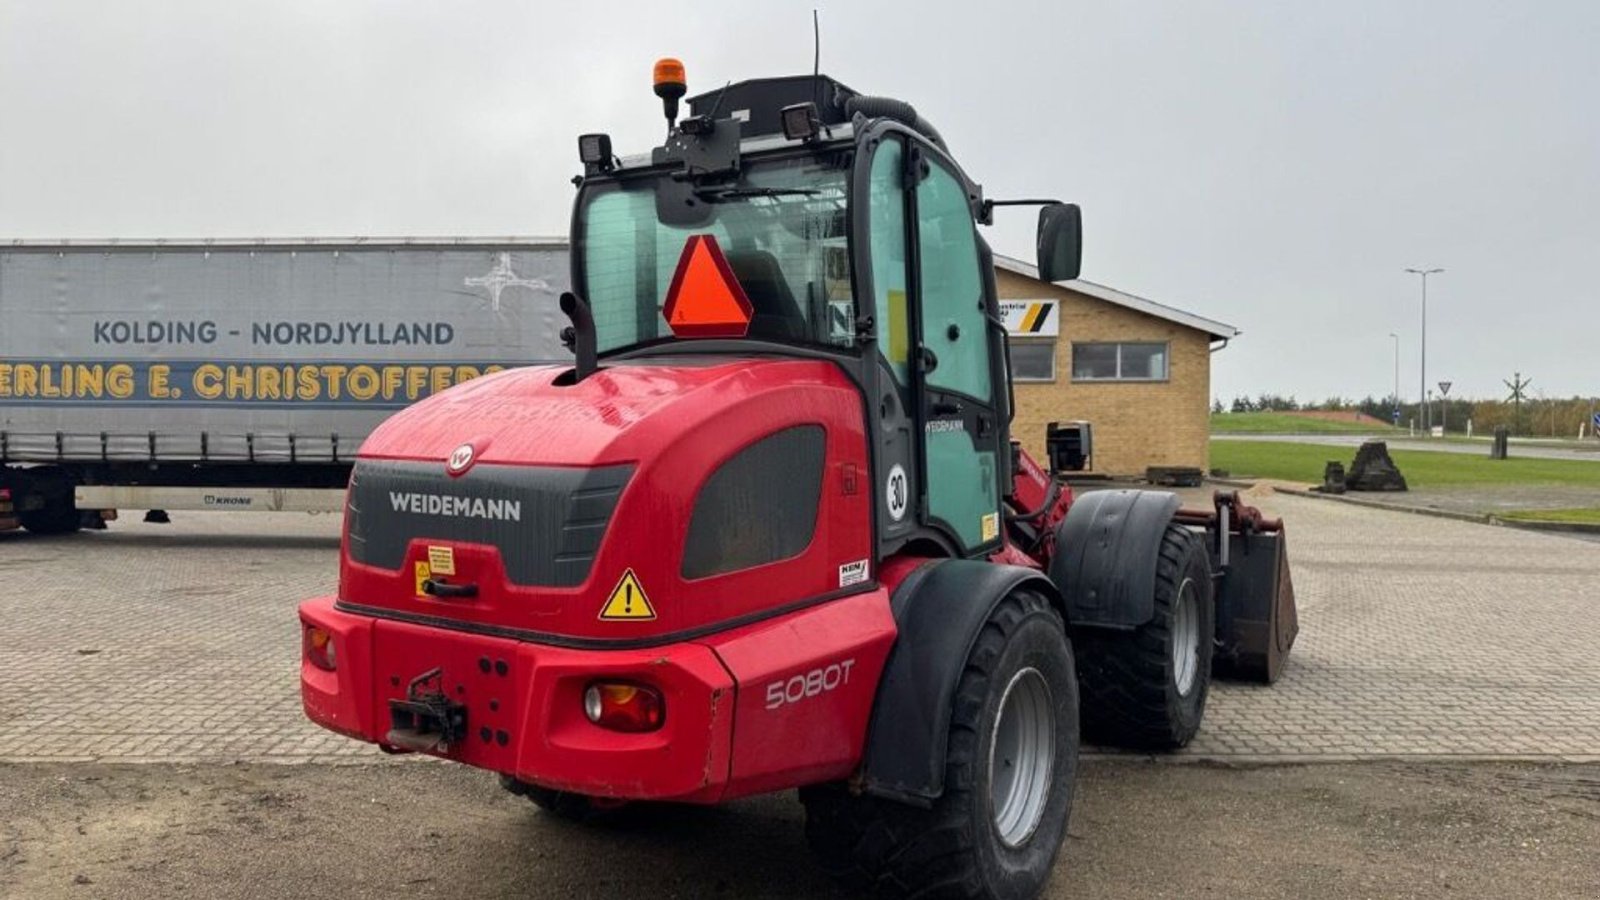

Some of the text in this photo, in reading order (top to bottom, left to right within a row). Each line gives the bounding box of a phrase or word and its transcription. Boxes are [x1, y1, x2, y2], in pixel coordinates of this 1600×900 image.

[94, 321, 217, 343] KOLDING
[252, 322, 454, 345] NORDJYLLAND
[149, 365, 182, 399] E.
[192, 364, 505, 400] CHRISTOFFE
[389, 491, 520, 521] WEIDEMANN
[891, 475, 904, 510] 30
[765, 659, 855, 709] 5080T
